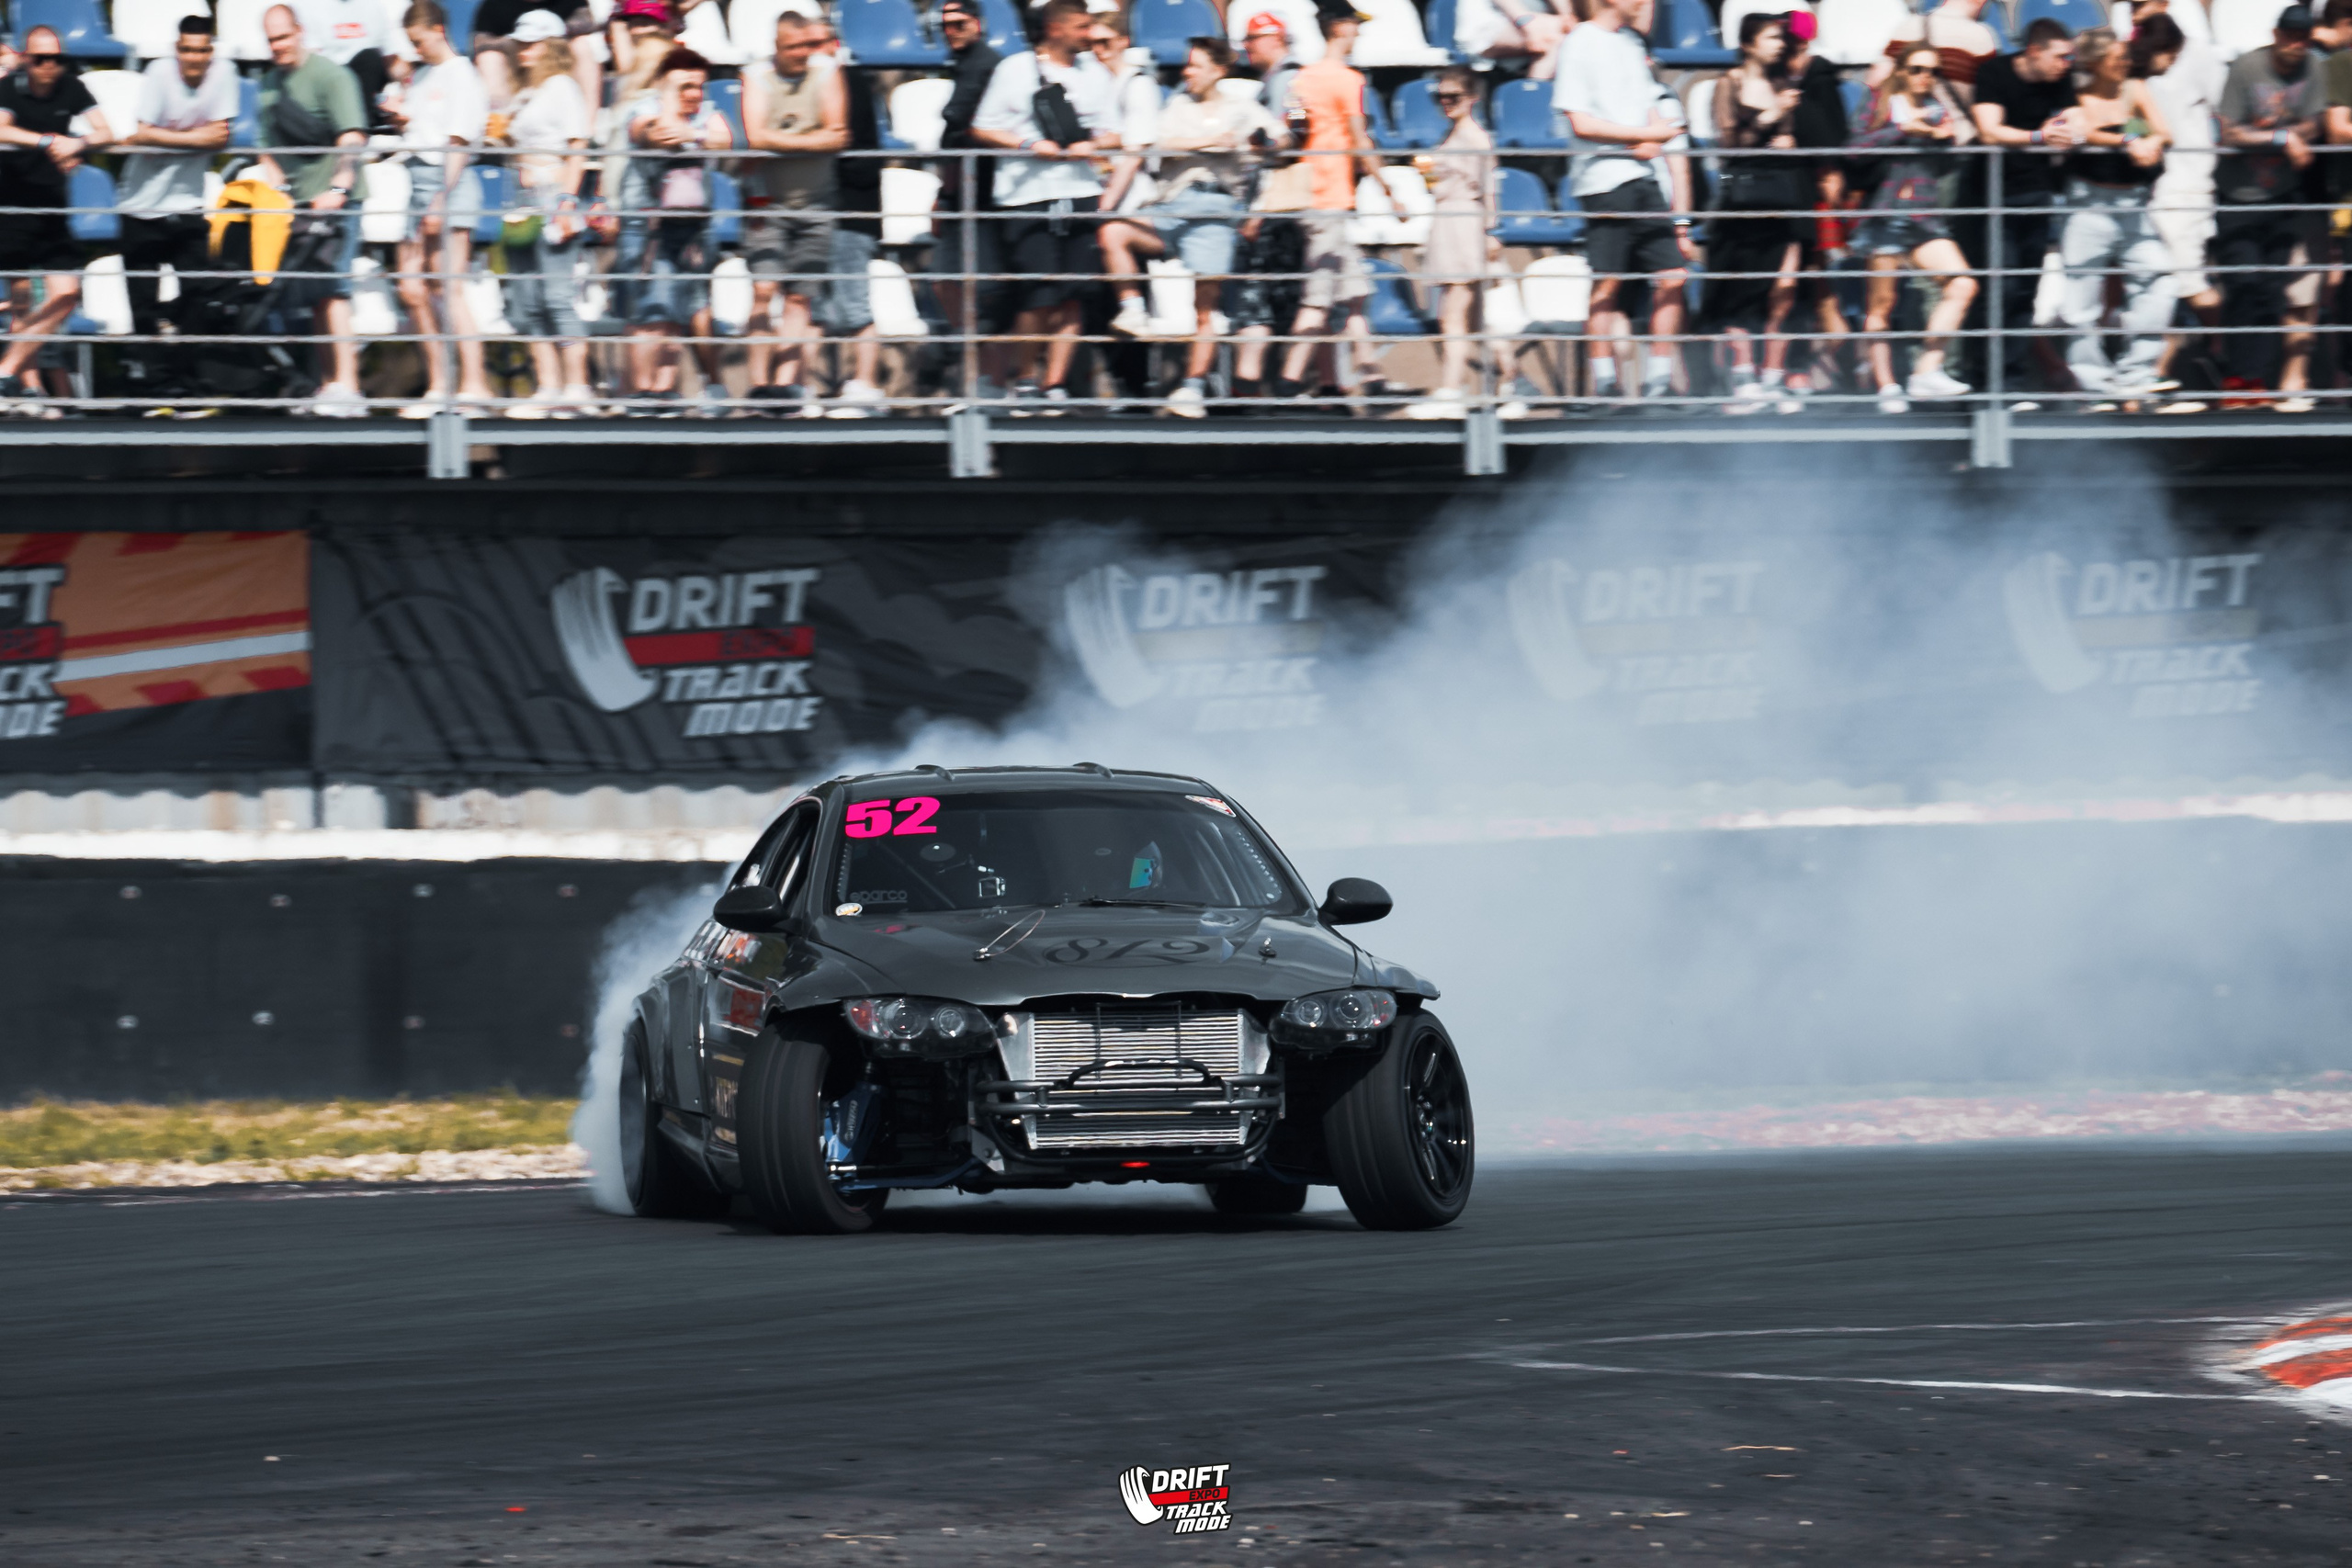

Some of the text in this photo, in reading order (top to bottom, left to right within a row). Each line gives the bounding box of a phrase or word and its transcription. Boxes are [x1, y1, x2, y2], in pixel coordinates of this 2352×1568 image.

[627, 567, 822, 634] DRIFT
[1137, 565, 1329, 629] DRIFT
[1581, 559, 1765, 623] DRIFT
[2076, 553, 2263, 615] DRIFT
[845, 796, 941, 839] 52
